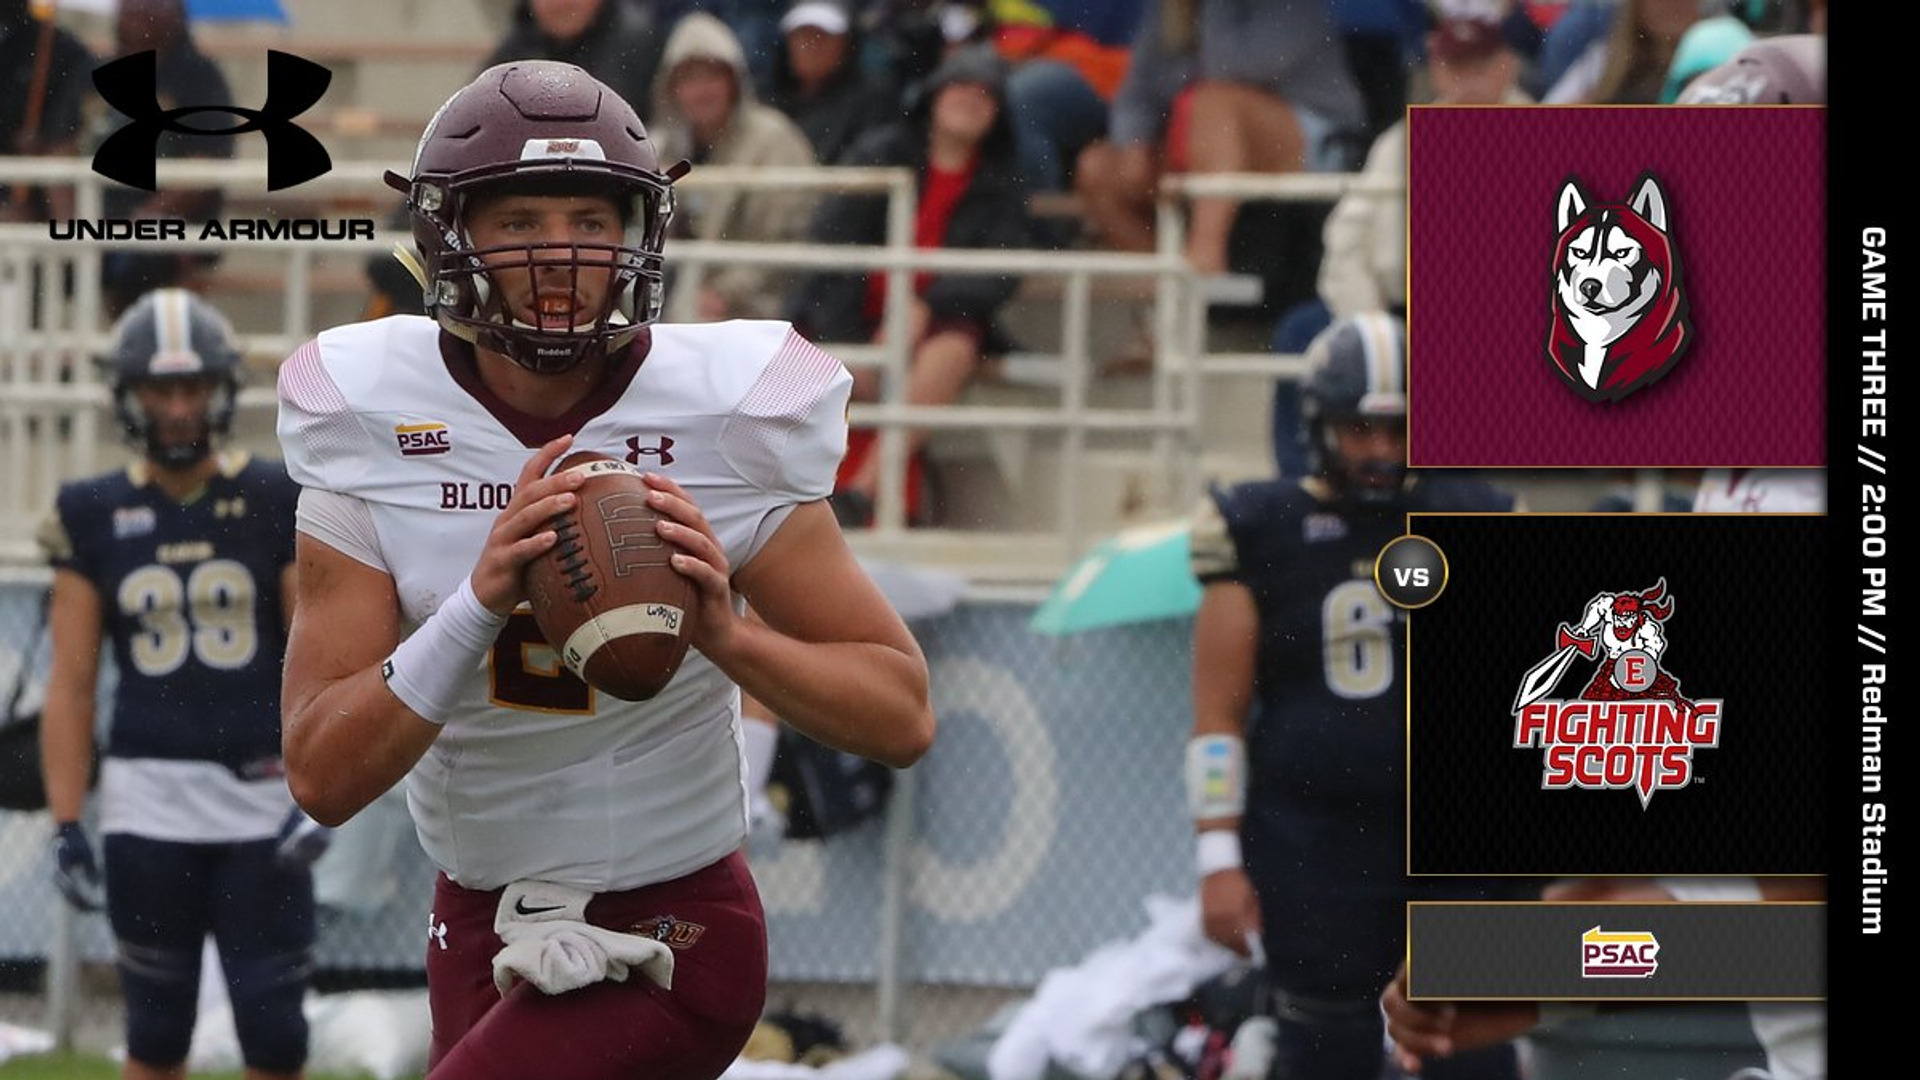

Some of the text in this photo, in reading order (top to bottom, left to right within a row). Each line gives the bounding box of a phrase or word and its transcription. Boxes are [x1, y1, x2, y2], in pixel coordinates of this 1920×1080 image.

[397, 430, 449, 447] PSAC
[440, 482, 517, 509] BLOO
[118, 559, 258, 677] 39
[487, 601, 597, 716] 2
[1322, 578, 1407, 699] 6
